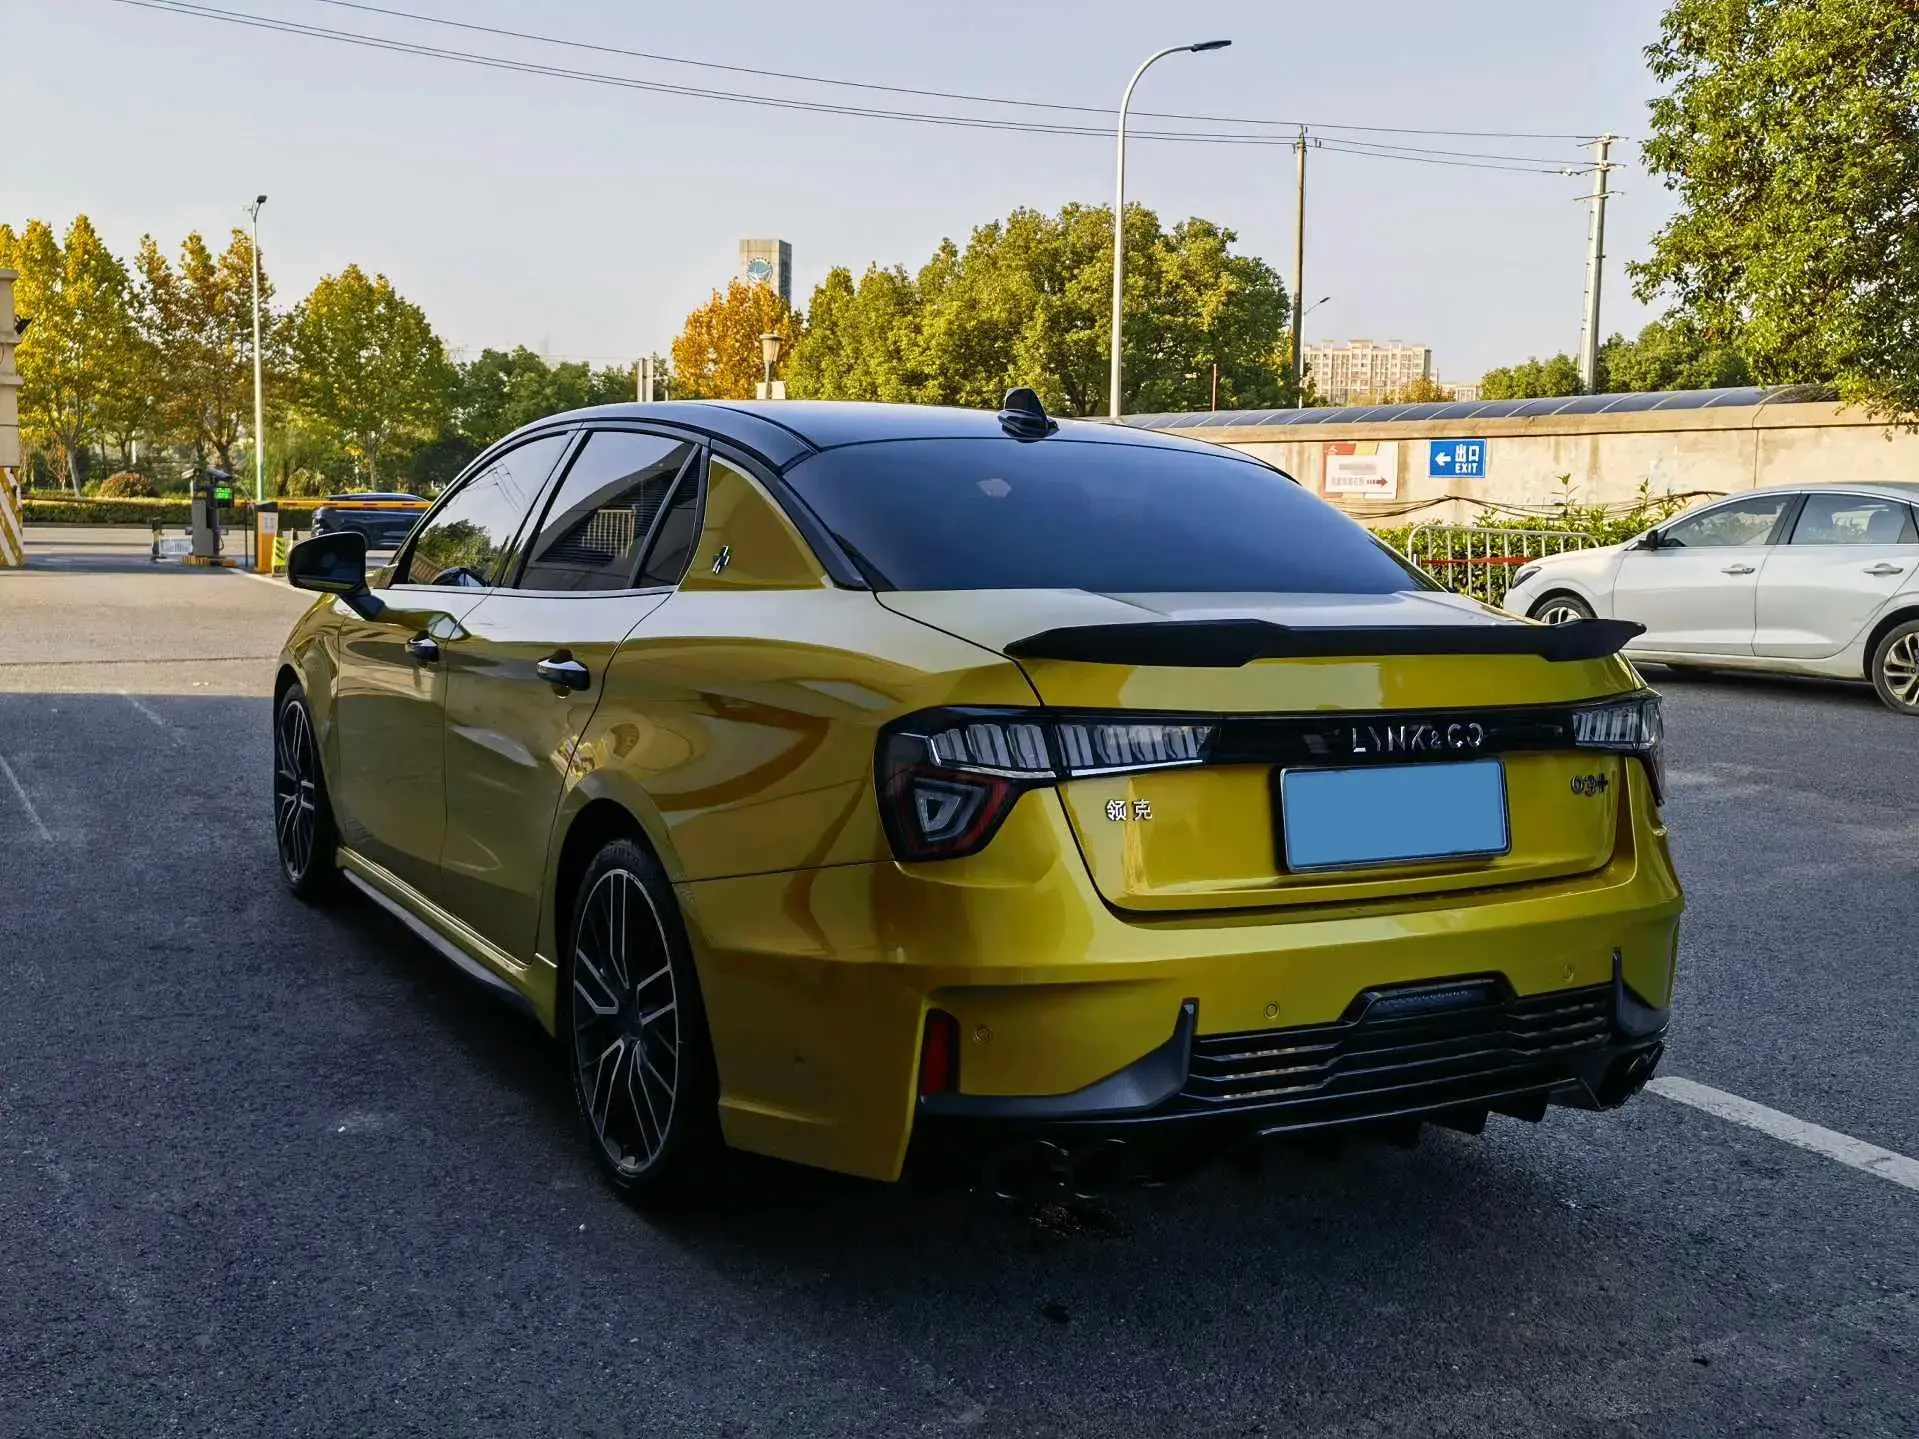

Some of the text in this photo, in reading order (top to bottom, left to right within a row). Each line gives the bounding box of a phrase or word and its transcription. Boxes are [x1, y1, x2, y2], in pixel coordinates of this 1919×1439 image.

[1455, 444, 1480, 462] 出口
[1455, 463, 1478, 474] EXIT
[1105, 799, 1153, 820] 领克
